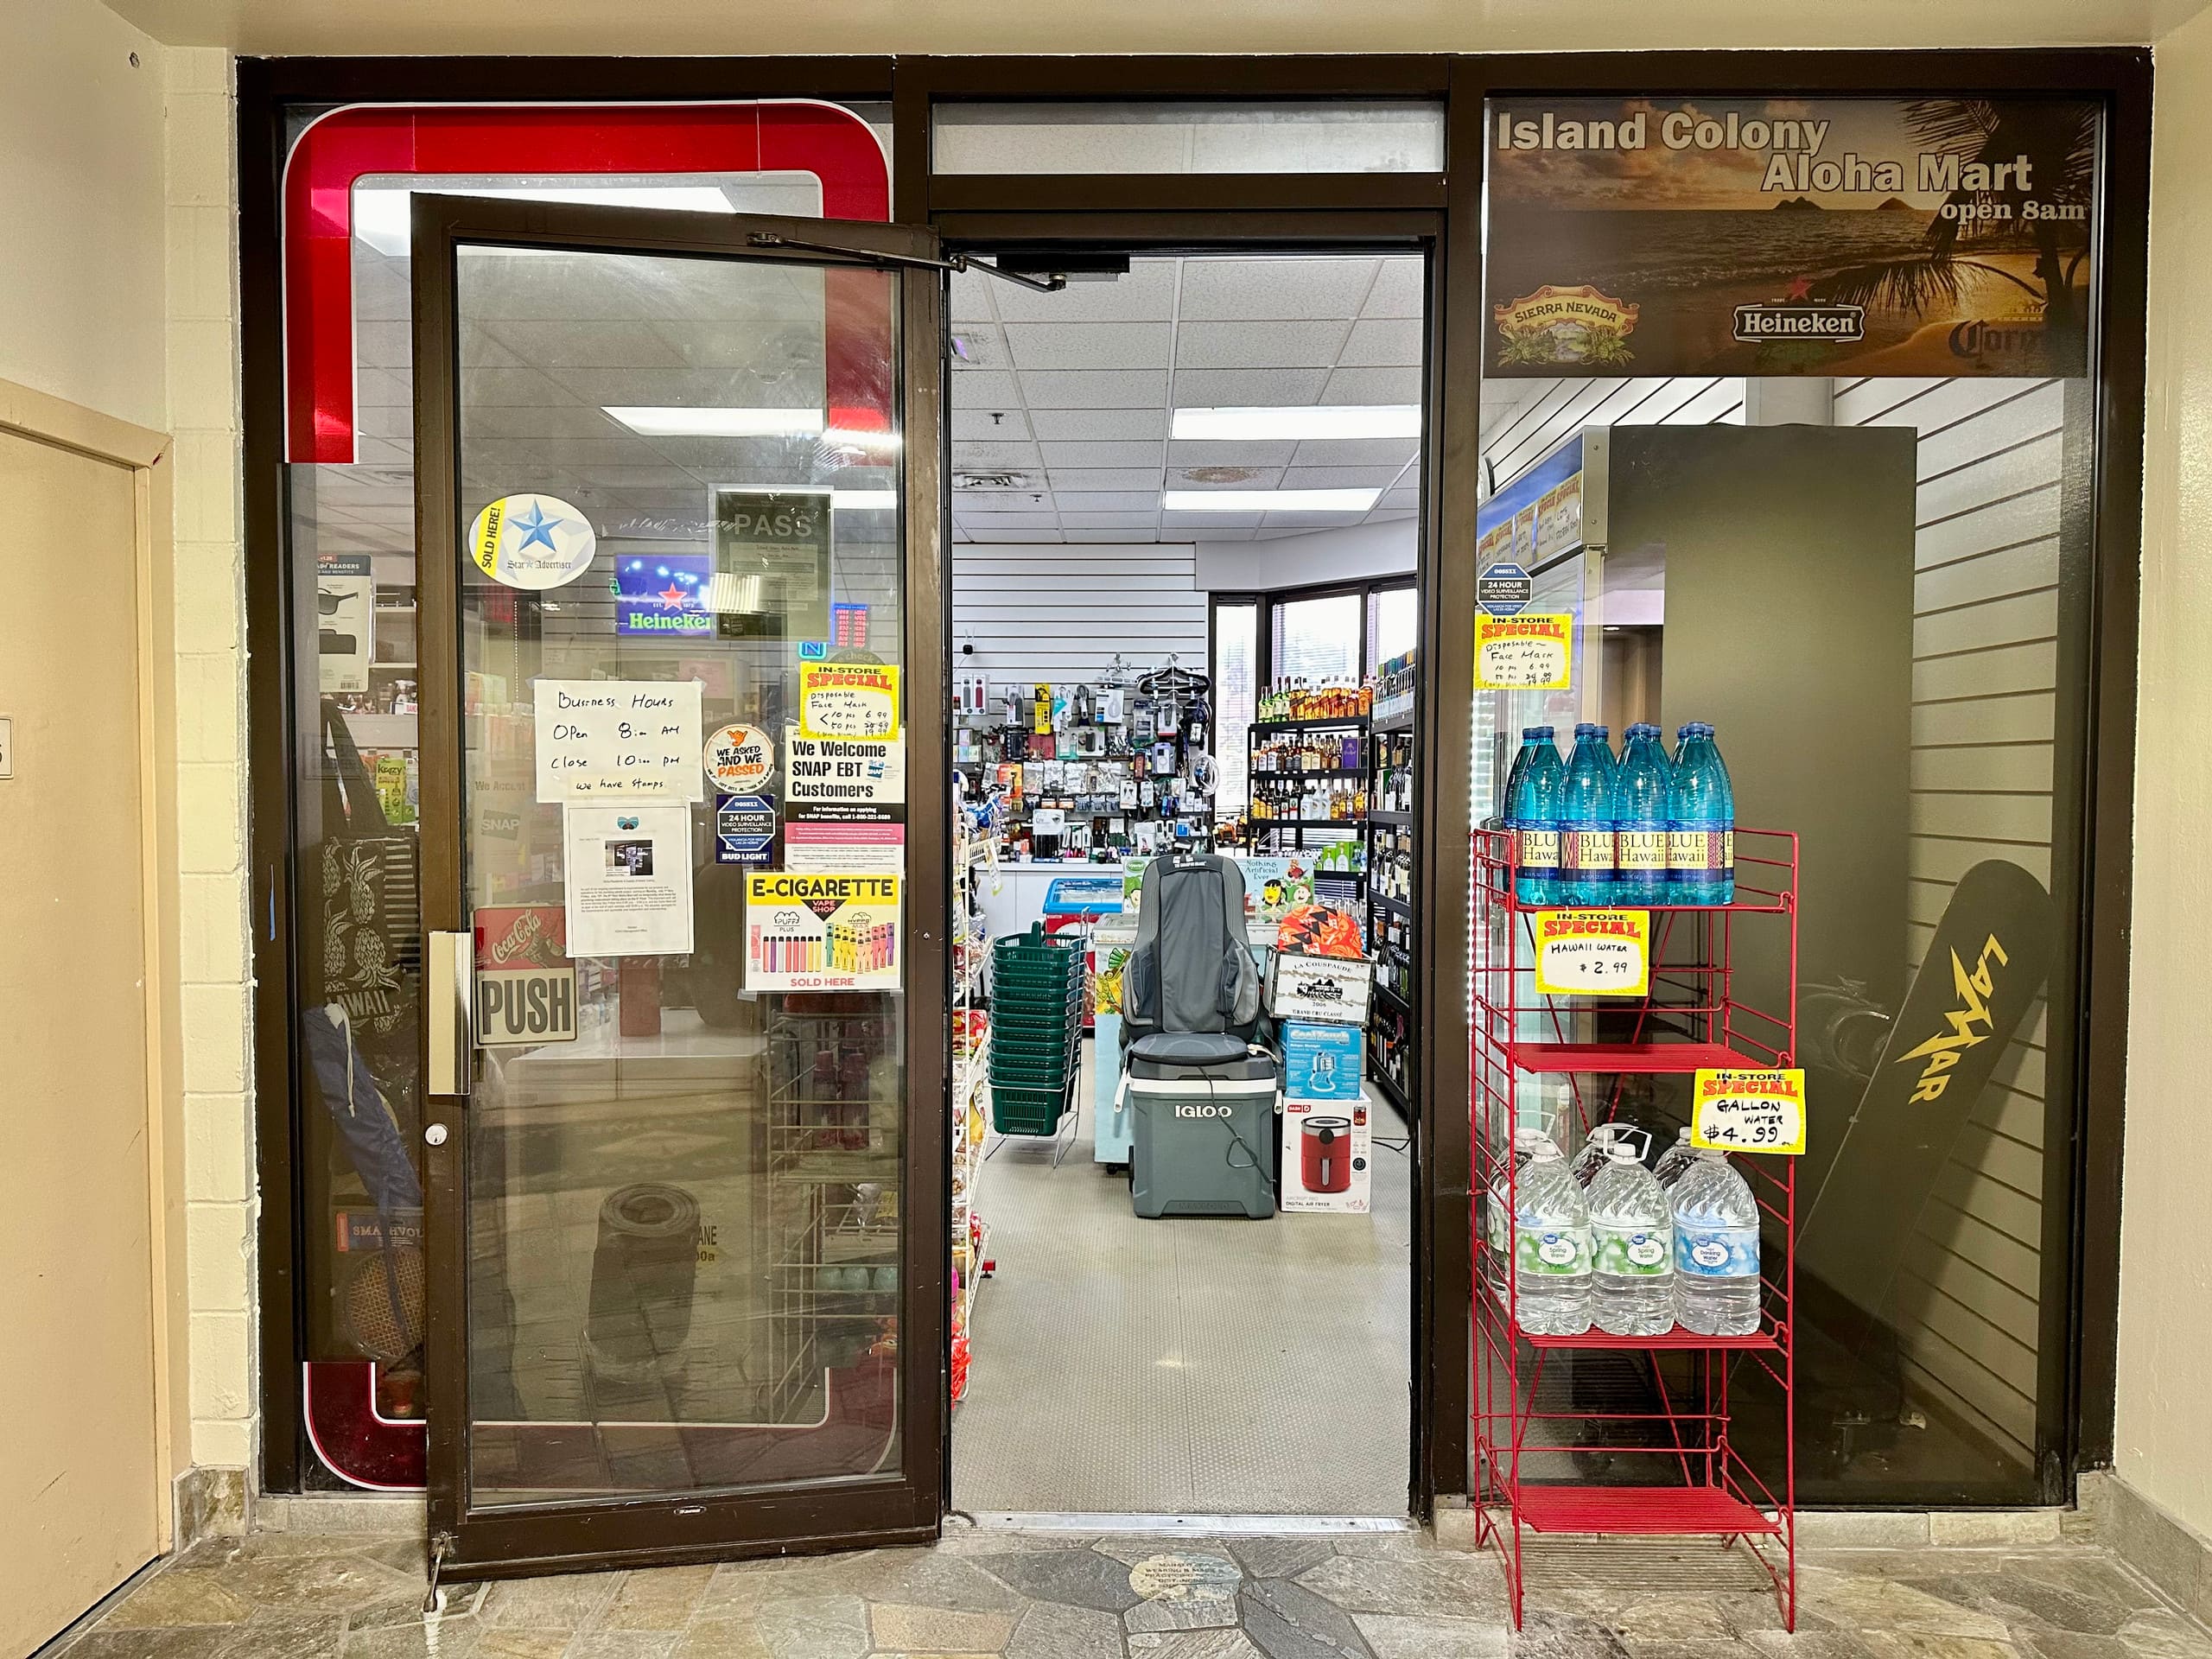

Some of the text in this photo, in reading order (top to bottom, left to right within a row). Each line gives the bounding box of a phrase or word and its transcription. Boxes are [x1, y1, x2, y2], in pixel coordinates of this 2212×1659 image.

[1498, 112, 1830, 157] Island Colony
[1761, 153, 2032, 192] Aloha Mart
[1939, 200, 2086, 226] open 8am
[1515, 302, 1618, 323] SIERRA NEVADA
[1744, 312, 1854, 334] Heineken
[734, 513, 812, 537] PASS
[482, 507, 501, 569] SOLD HERE!
[507, 560, 572, 569] Star Advertiser
[1481, 624, 1565, 639] SPECIAL
[1491, 652, 1514, 661] Face
[807, 672, 892, 690] SPECIAL
[558, 691, 673, 709] Business Hours
[661, 726, 679, 734] AM
[733, 746, 760, 754] ASKED
[792, 741, 887, 757] We Welcome
[663, 756, 680, 766] PM
[717, 753, 762, 766] AND WE
[718, 763, 765, 778] PASSED
[792, 760, 863, 777] SNAP EBT
[475, 781, 490, 791] We
[600, 779, 623, 788] have
[792, 781, 874, 798] Customers
[481, 819, 519, 830] SNAP
[1523, 834, 1556, 847] BLU
[1580, 834, 1614, 848] BLU
[1620, 834, 1664, 848] BLUE
[1524, 847, 1558, 860] Hawa
[1580, 849, 1614, 861] Hawa
[1619, 849, 1664, 862] Hawaii
[753, 879, 893, 897] E-CIGARETTE
[492, 908, 542, 964] Coca-Cola
[1544, 921, 1641, 938] SPECIAL
[1551, 944, 1592, 954] HAWAII
[1593, 962, 1628, 975] 2.99
[791, 978, 821, 987] SOLD
[327, 989, 391, 1017] AWAII
[482, 977, 571, 1037] PUSH
[1894, 932, 2009, 1105] LAMAR
[1703, 1079, 1798, 1097] SPECIAL
[1175, 1105, 1232, 1118] IGLOO
[1717, 1099, 1781, 1113] GALLON
[1745, 1115, 1783, 1125] WATER
[1704, 1124, 1778, 1145] $4.99
